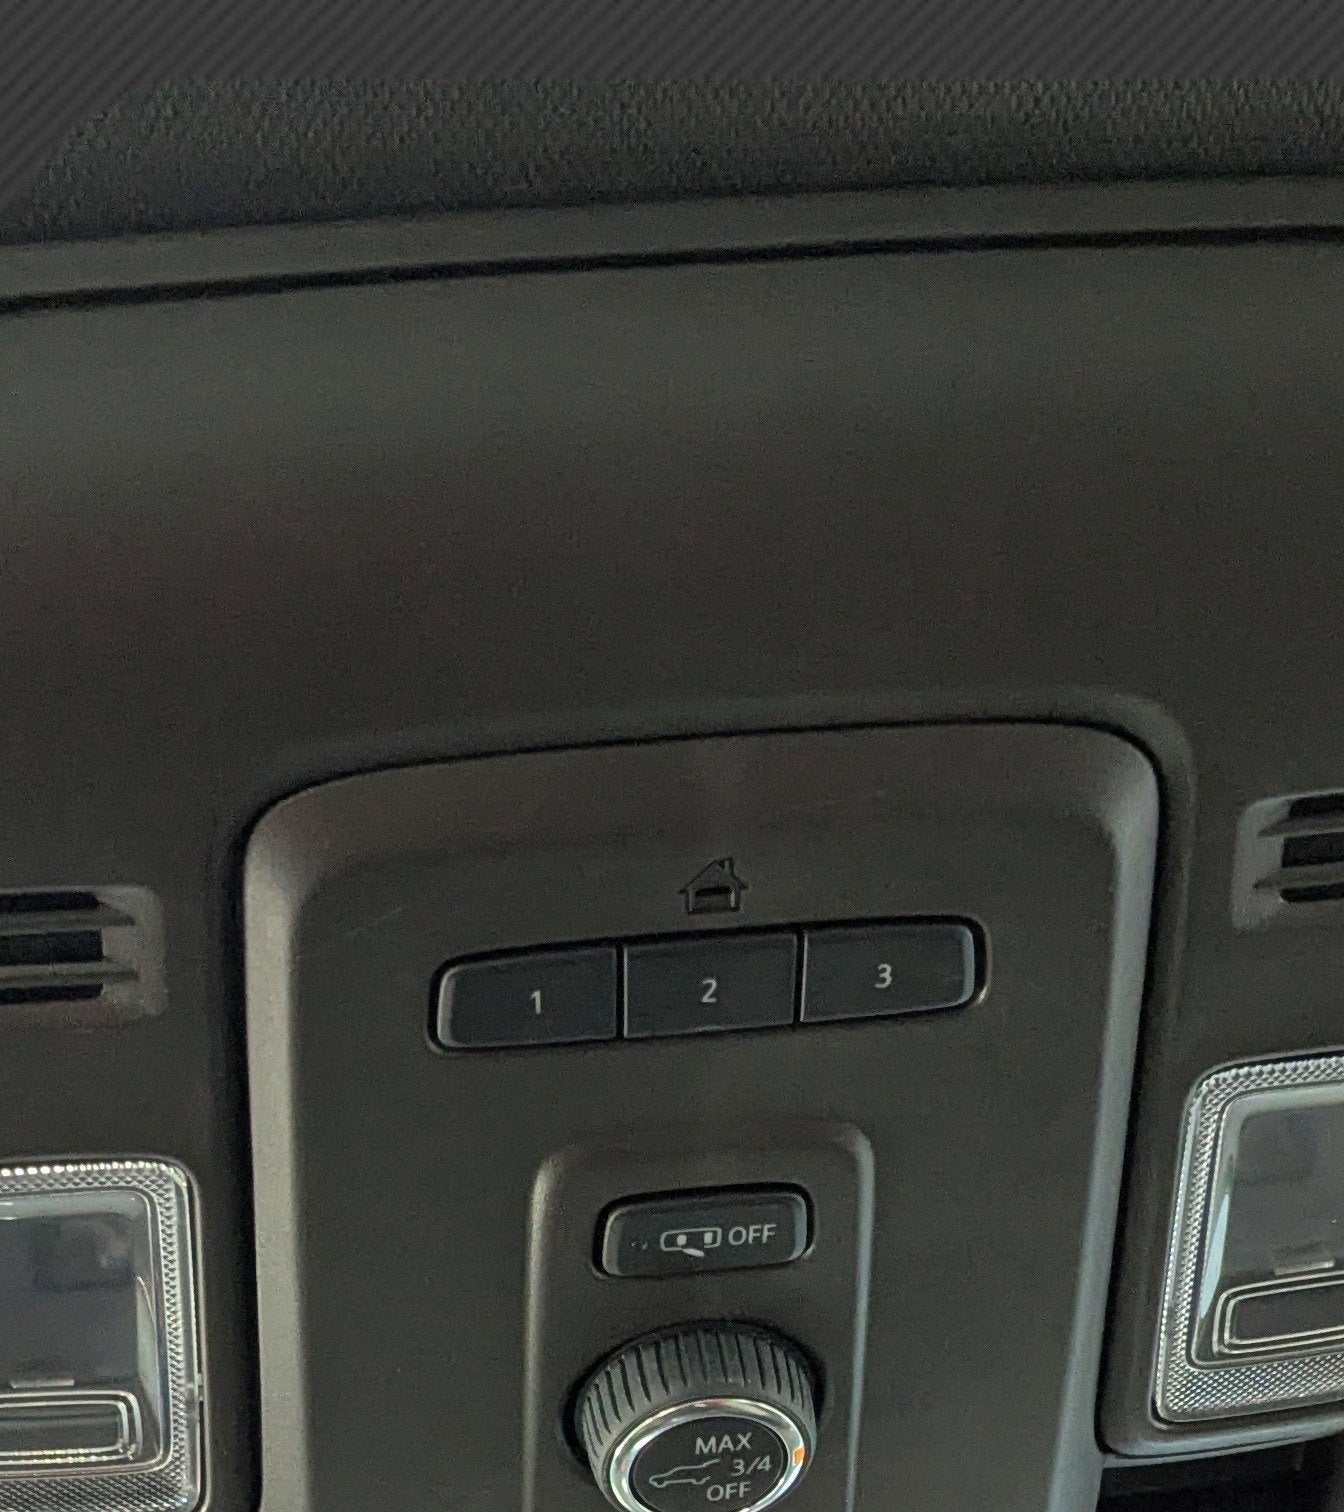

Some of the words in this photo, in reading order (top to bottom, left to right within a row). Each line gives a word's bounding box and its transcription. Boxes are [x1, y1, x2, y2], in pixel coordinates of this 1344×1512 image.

[873, 963, 893, 990] 3
[529, 990, 542, 1016] 1
[700, 978, 718, 1004] 2
[727, 1223, 777, 1247] OFF
[695, 1431, 753, 1456] MAX
[731, 1456, 772, 1478] 3/4
[705, 1481, 752, 1502] OFF
